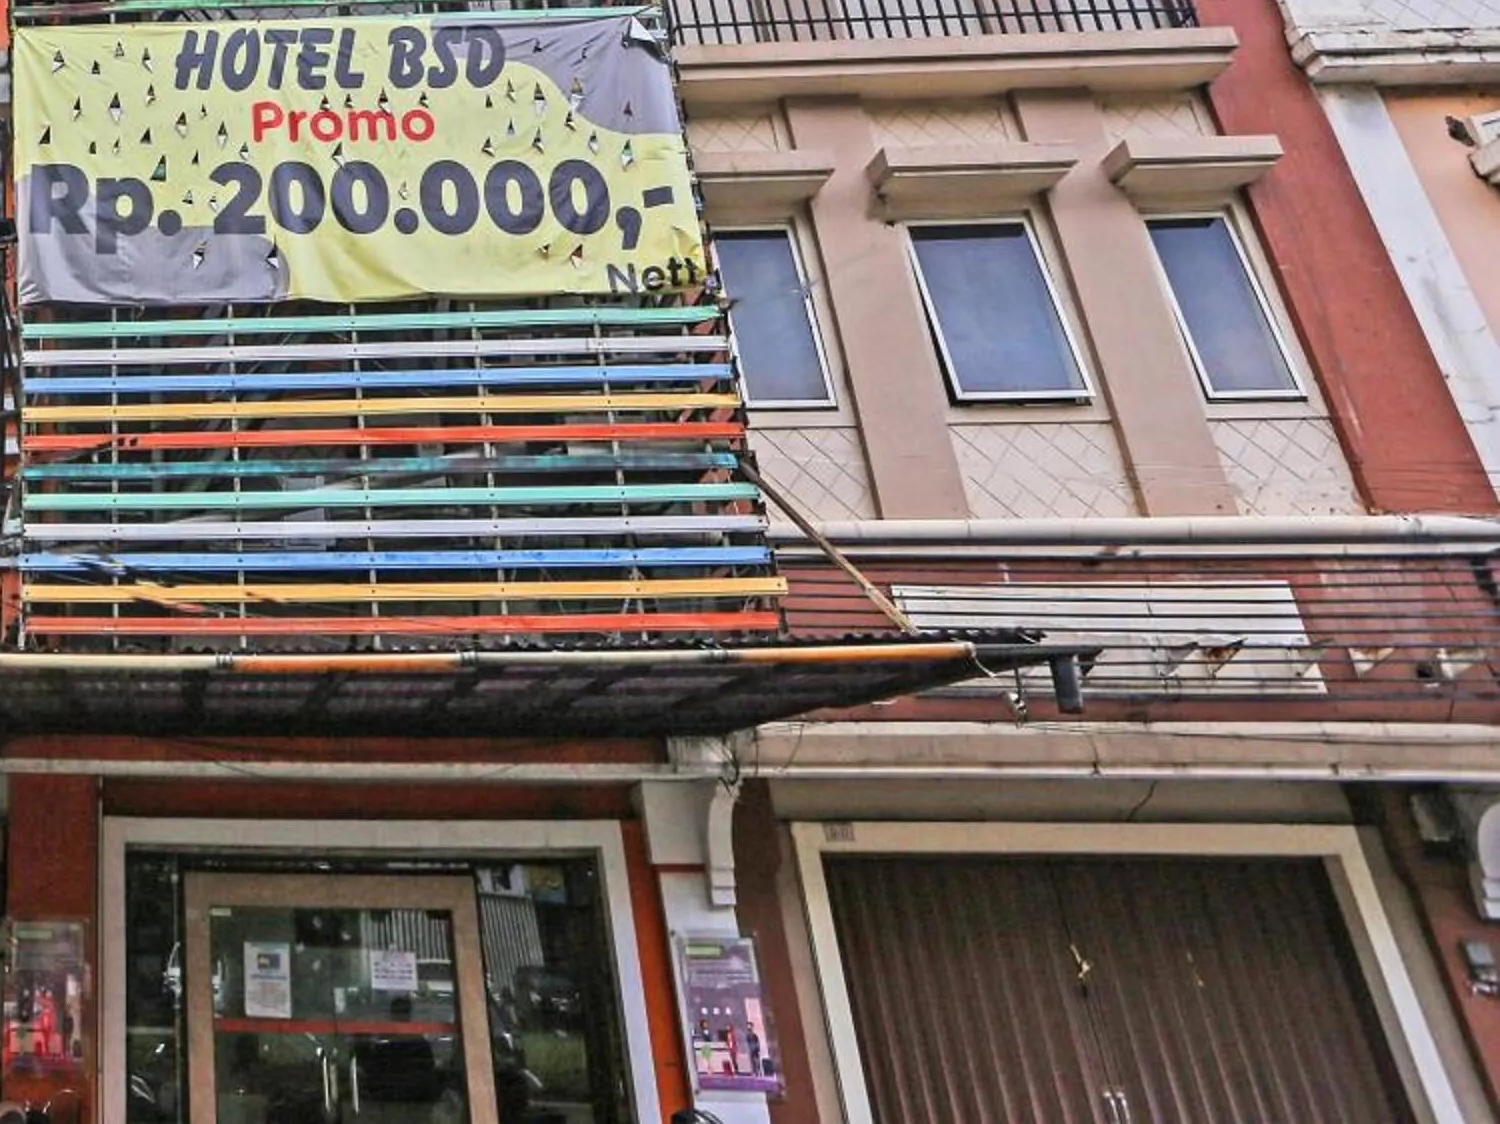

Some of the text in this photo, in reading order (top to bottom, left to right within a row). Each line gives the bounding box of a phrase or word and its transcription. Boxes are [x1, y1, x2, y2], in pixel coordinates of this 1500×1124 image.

[174, 25, 506, 92] HOTEL BSD
[252, 100, 436, 143] Promo
[29, 159, 675, 255] Rp. 200.000,-
